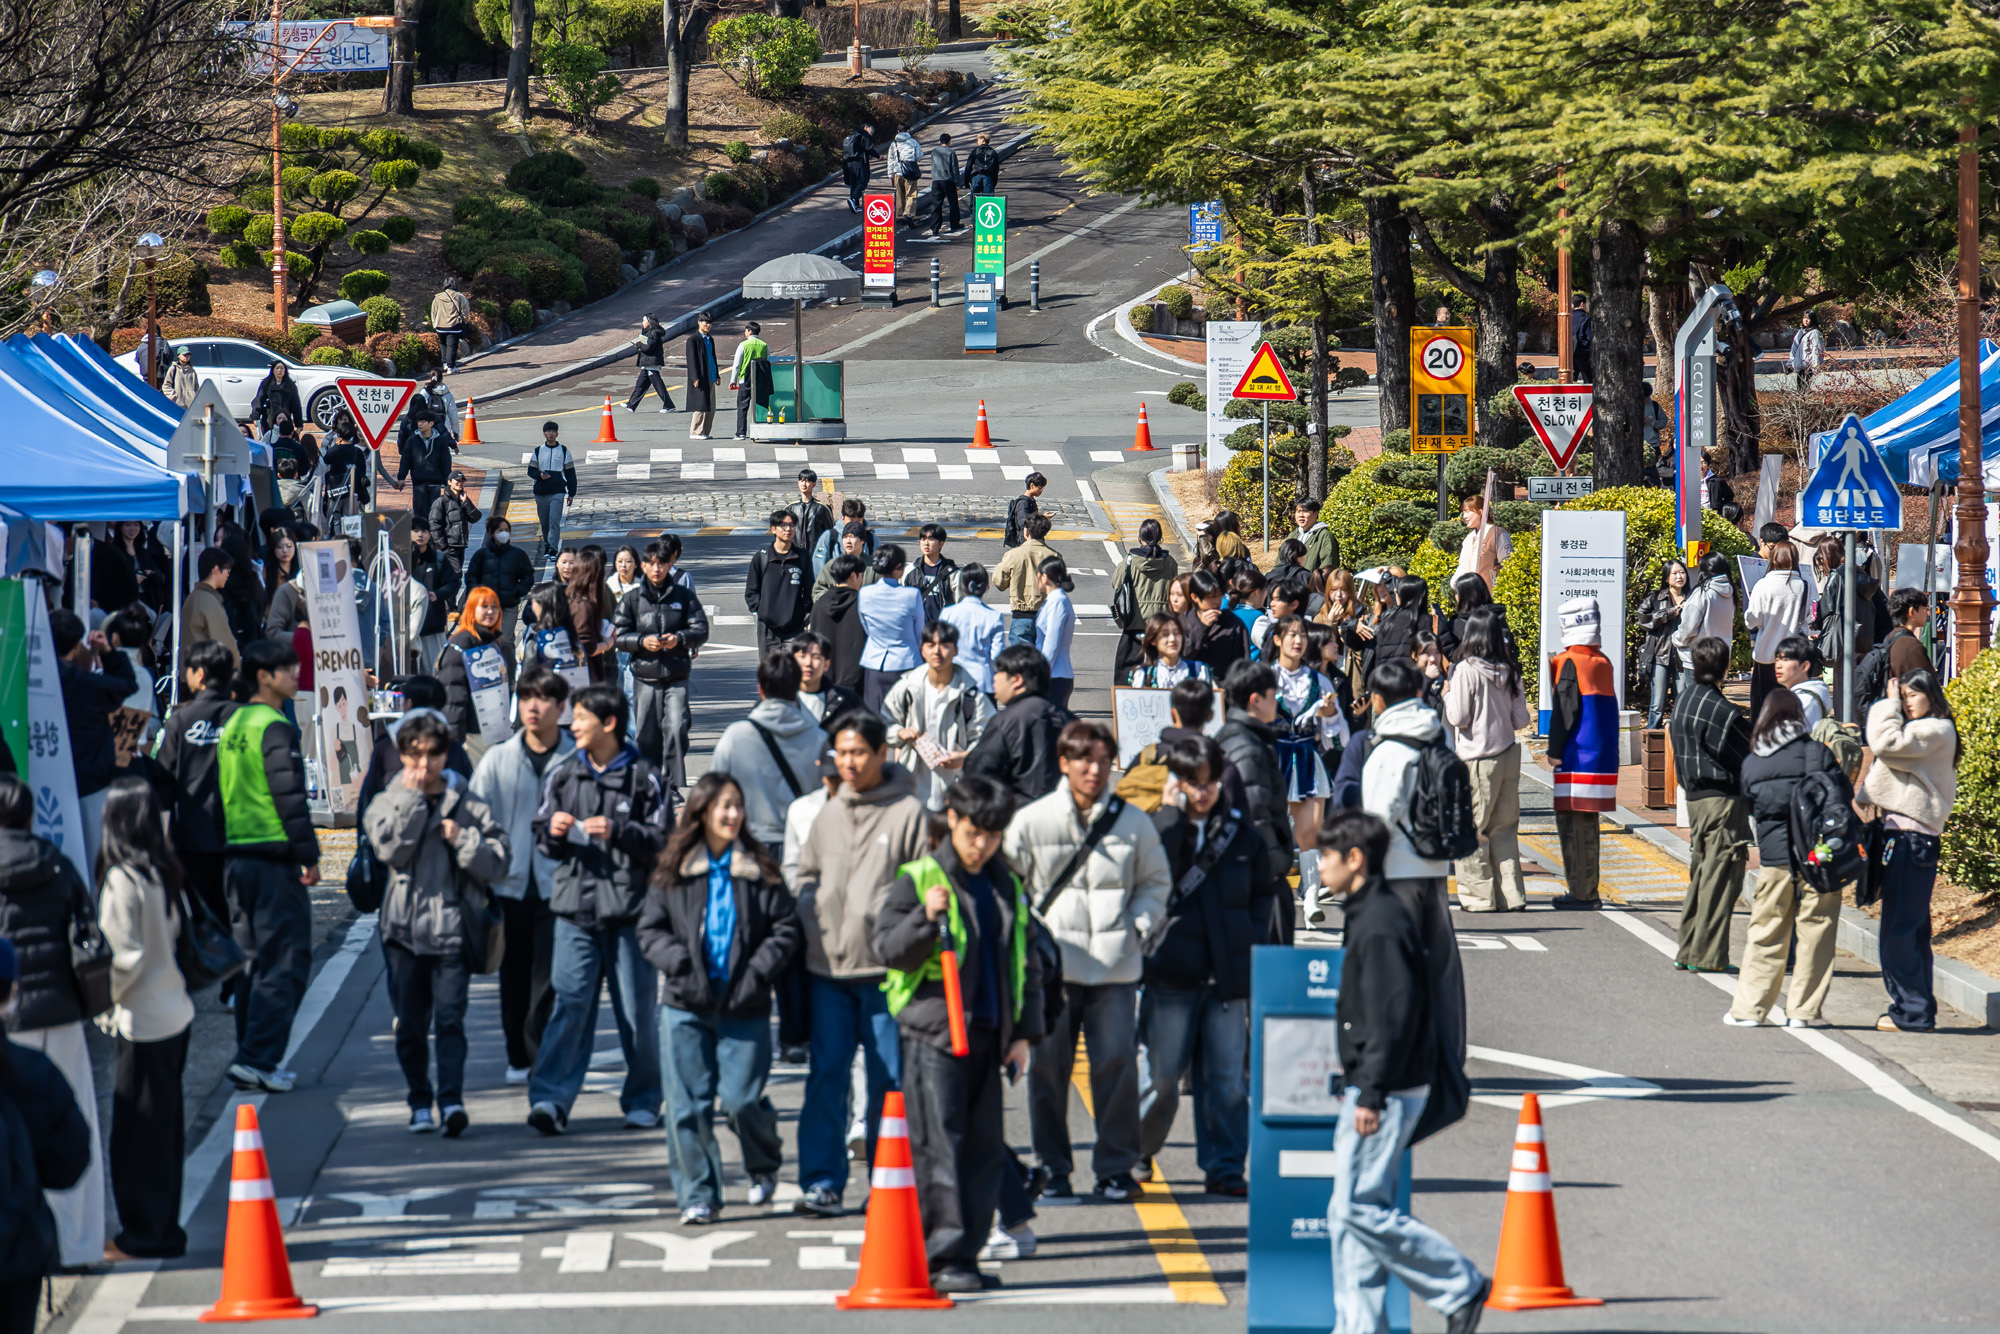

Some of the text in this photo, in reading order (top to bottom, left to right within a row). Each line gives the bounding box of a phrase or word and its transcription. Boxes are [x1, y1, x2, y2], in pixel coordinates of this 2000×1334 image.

[329, 45, 376, 66] 입니다.
[866, 249, 893, 258] 출입금지
[977, 245, 1003, 254] 전용도로
[1428, 348, 1458, 368] 20
[357, 388, 394, 402] 천천히
[1693, 362, 1703, 440] CCTV 작동중
[362, 403, 389, 413] SLOW
[1538, 396, 1582, 412] 천천히
[1544, 415, 1576, 426] SLOW
[1417, 437, 1470, 449] 현재속도
[1535, 482, 1592, 495] 교내전역
[1817, 509, 1885, 524] 횡단보도
[1560, 540, 1588, 549] 봉경관
[1565, 568, 1615, 577] 사회과학대학
[1565, 589, 1598, 598] 이부대학
[316, 648, 361, 673] CREMA
